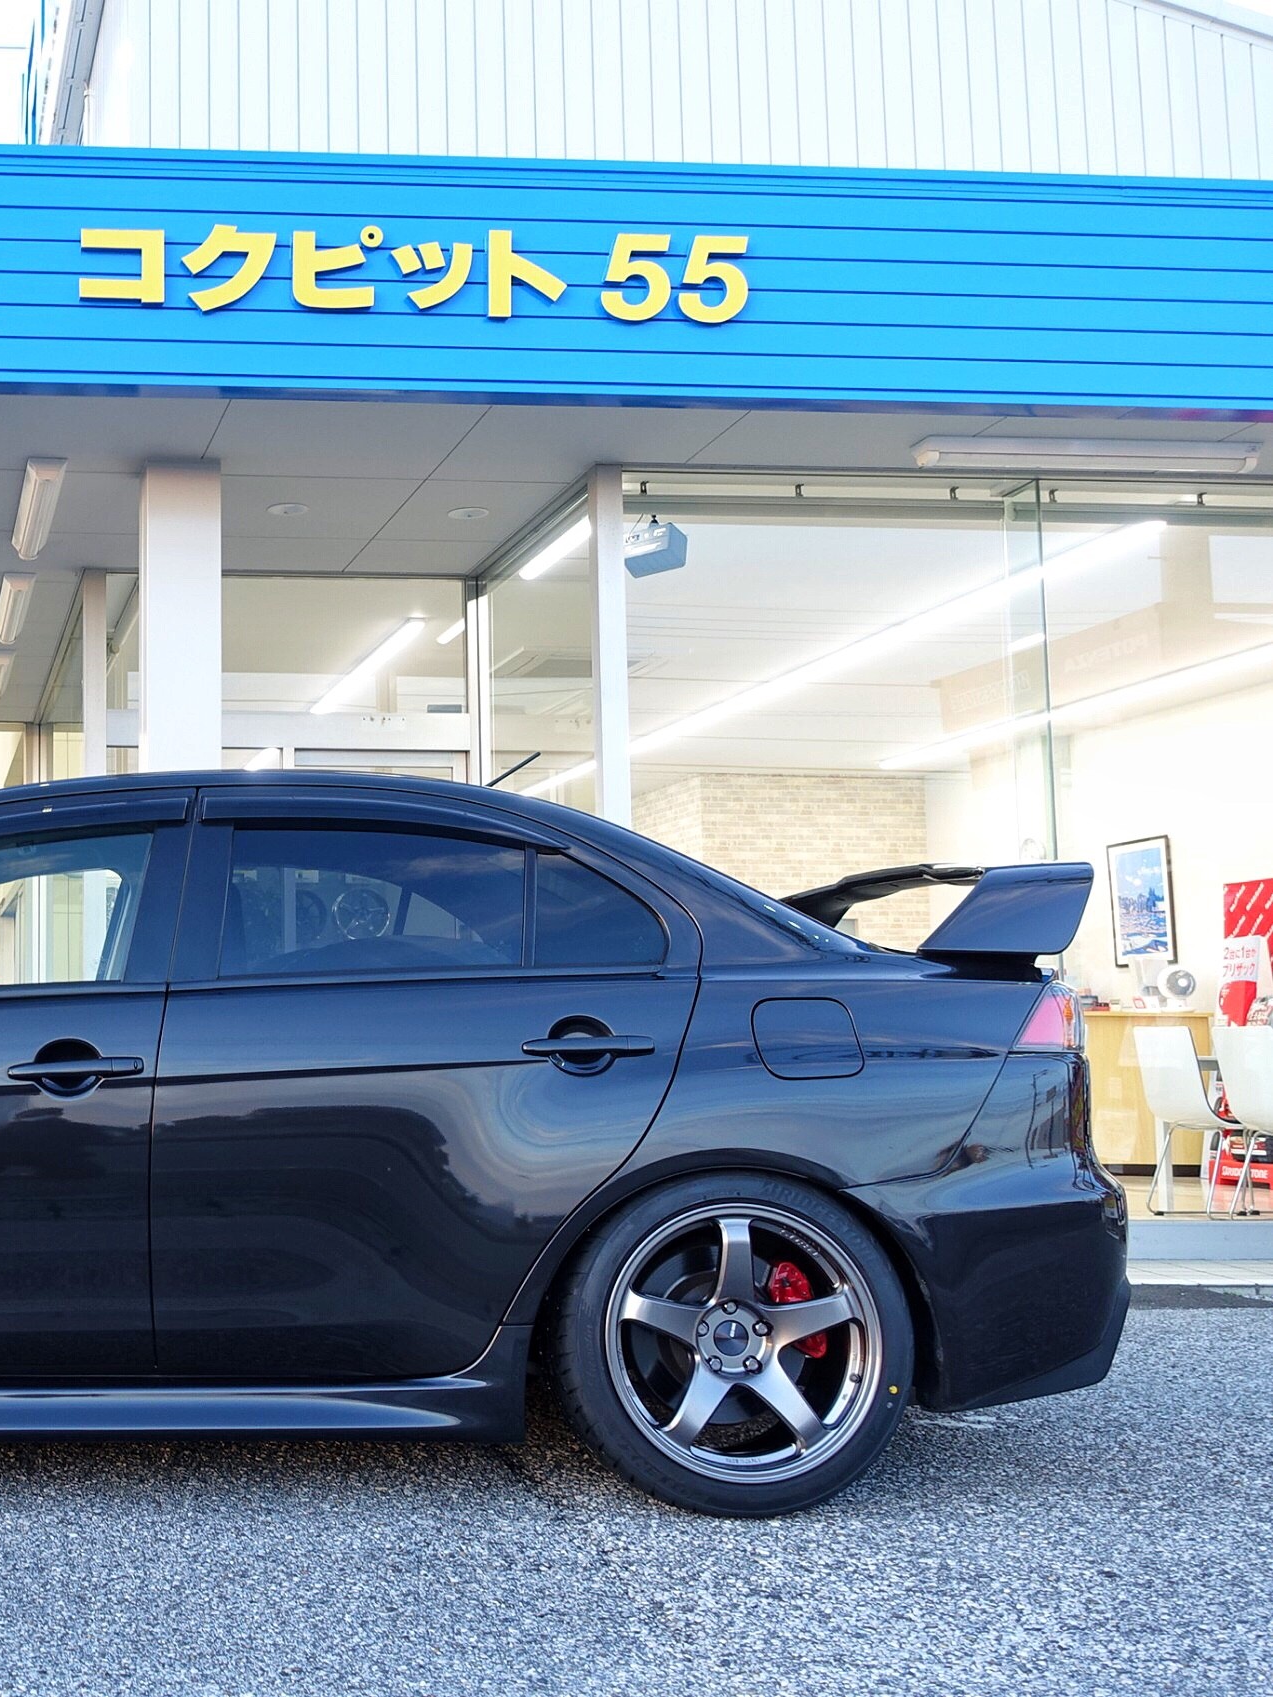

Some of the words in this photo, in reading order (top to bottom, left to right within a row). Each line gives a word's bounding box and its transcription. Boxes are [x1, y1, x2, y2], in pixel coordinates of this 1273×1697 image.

[79, 224, 568, 318] コクピット
[600, 234, 749, 324] 55
